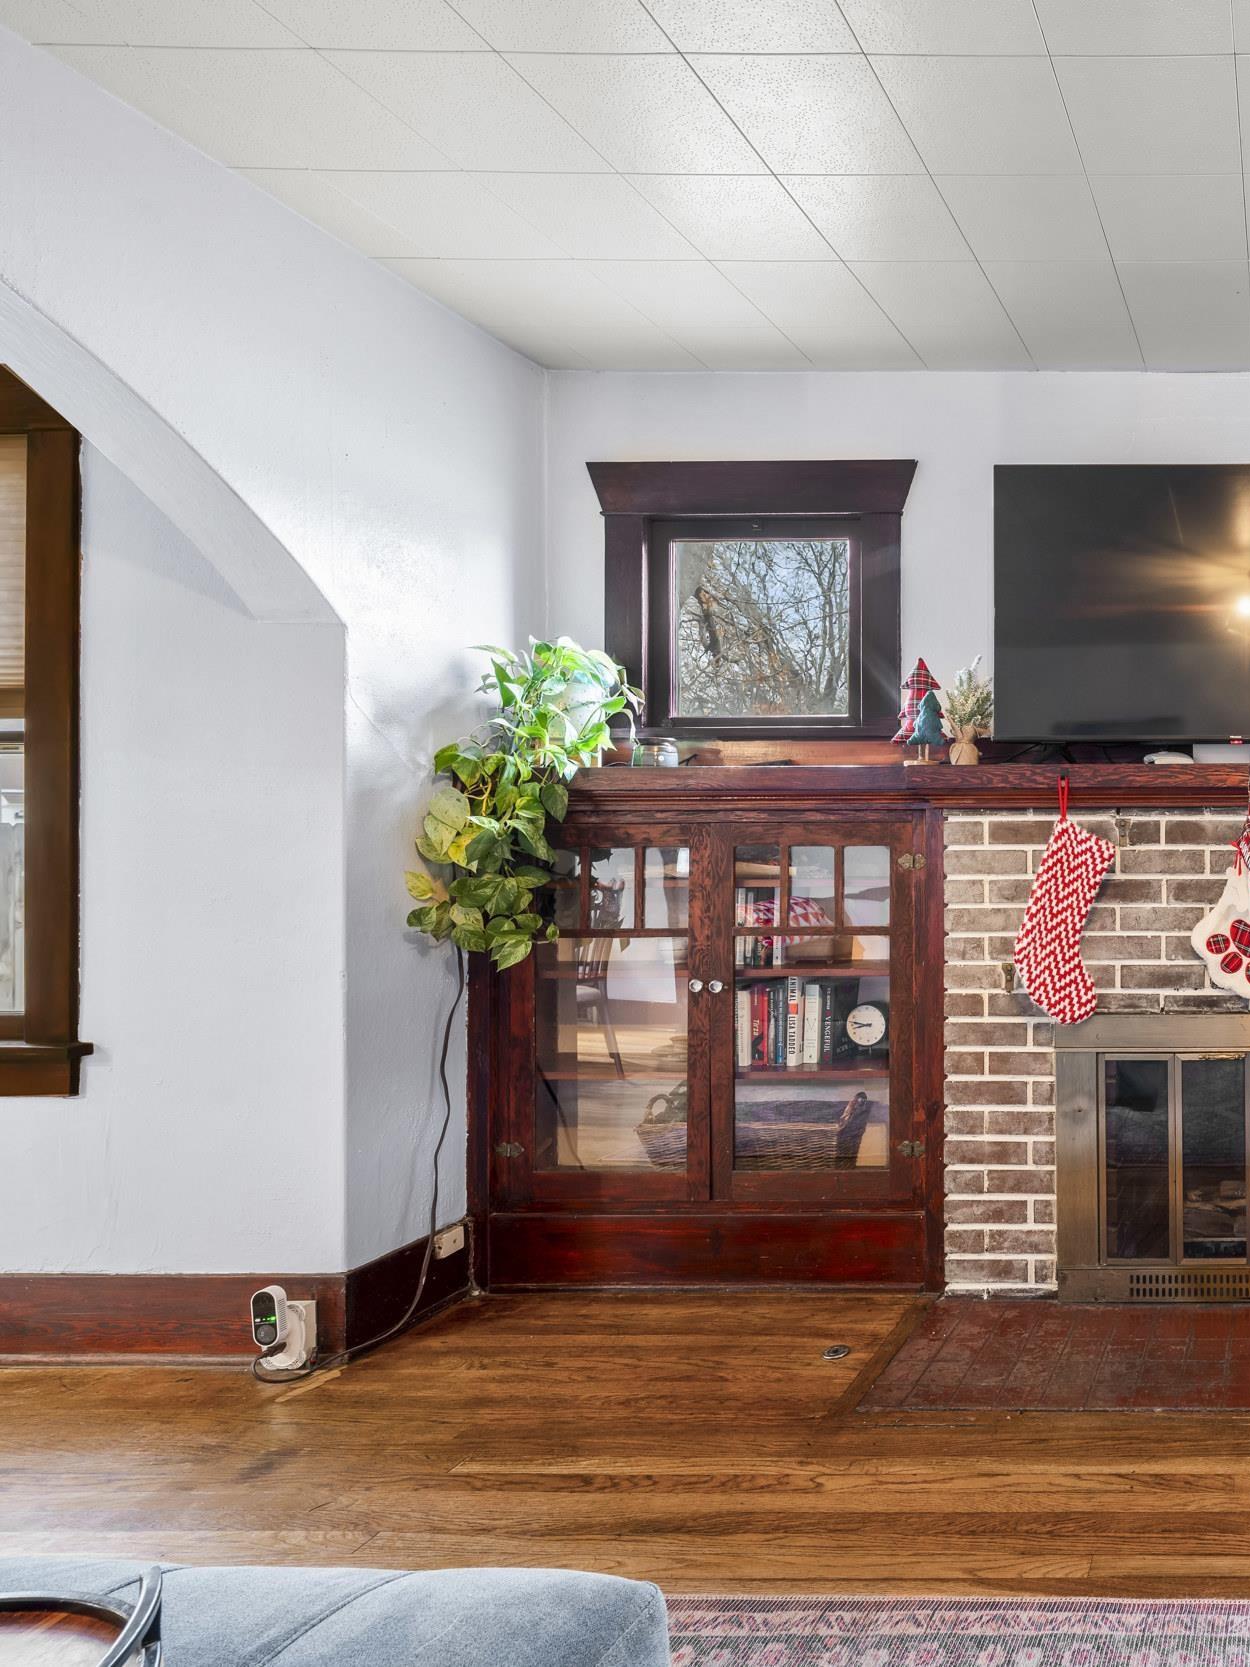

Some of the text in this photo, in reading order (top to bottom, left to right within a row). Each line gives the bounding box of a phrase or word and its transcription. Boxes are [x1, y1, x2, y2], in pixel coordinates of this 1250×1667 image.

[789, 977, 797, 1001] ANIMAL
[788, 1016, 796, 1055] LISA TADDEO
[823, 1016, 832, 1053] VENGEFUL
